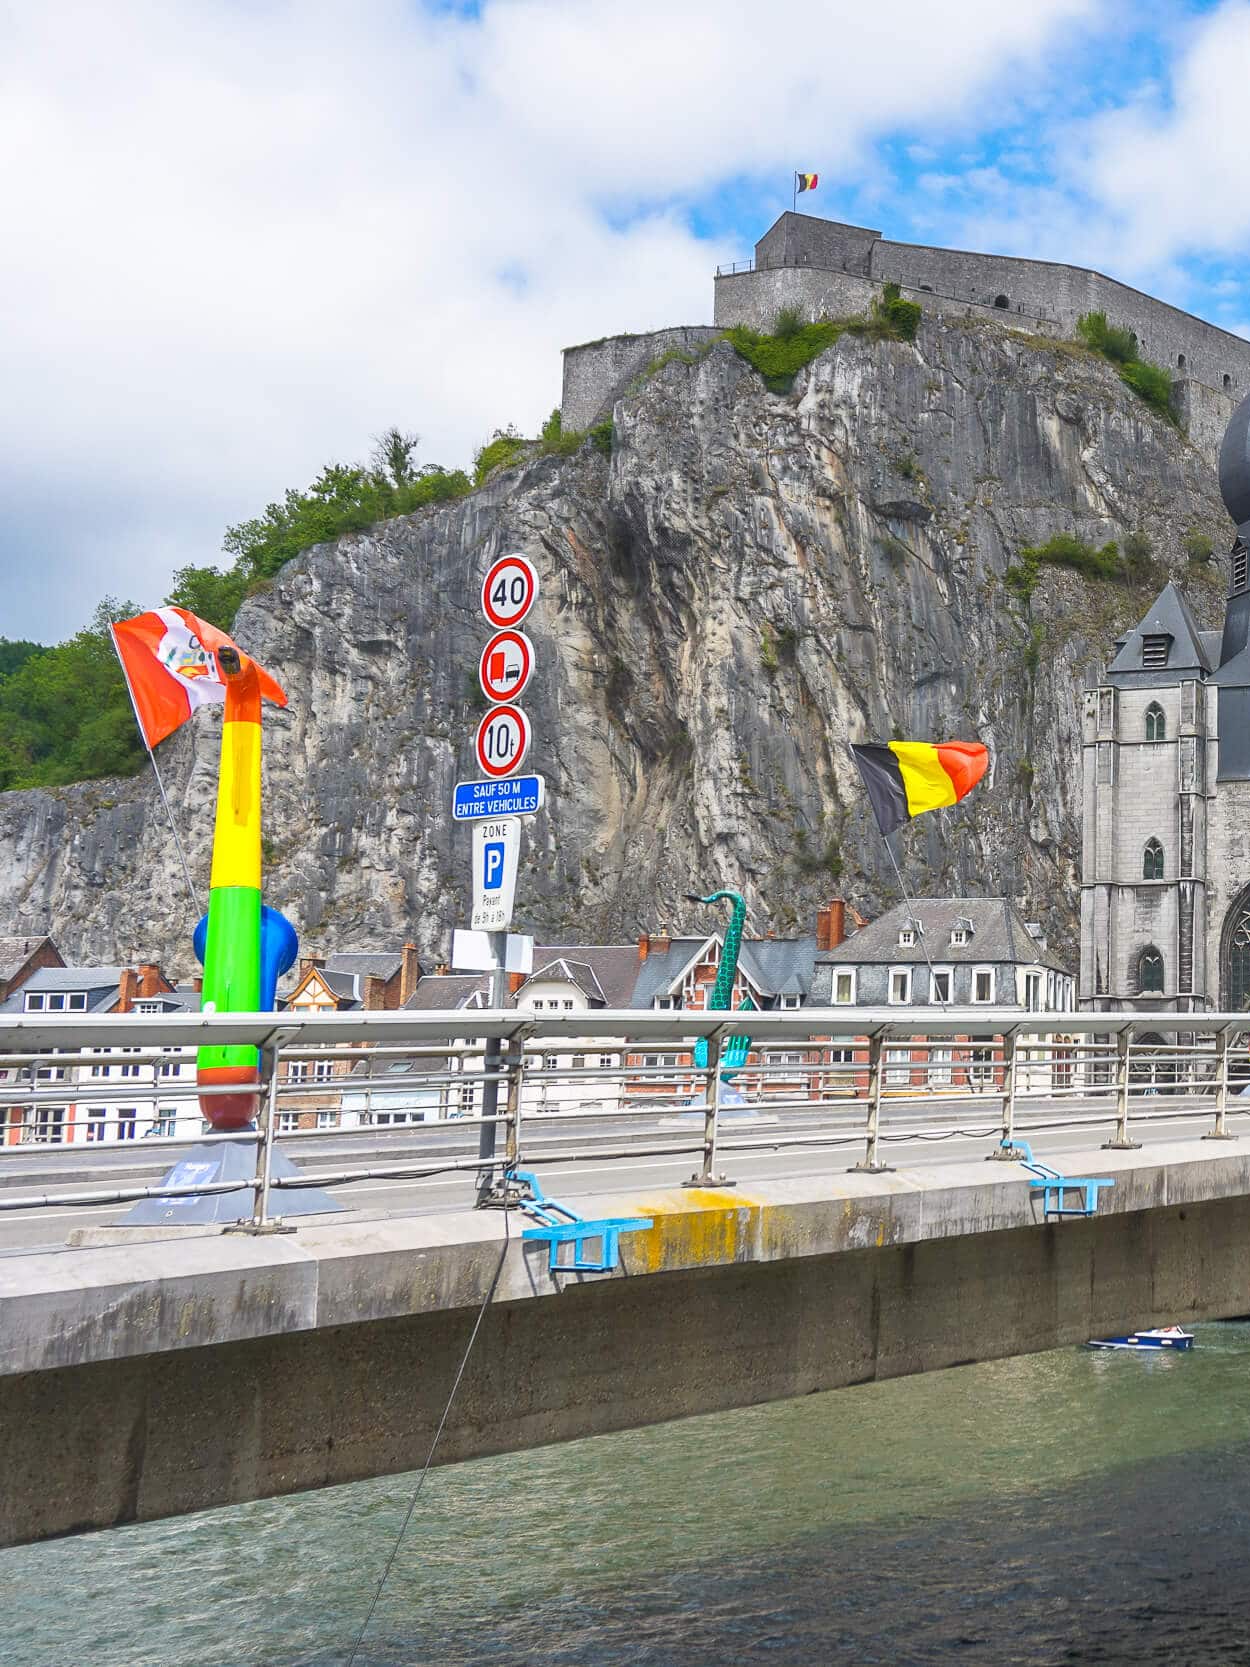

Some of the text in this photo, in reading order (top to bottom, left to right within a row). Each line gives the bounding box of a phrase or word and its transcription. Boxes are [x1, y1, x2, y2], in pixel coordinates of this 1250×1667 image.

[492, 577, 525, 606] 40
[473, 782, 520, 798] SAUF 50 M
[456, 796, 536, 816] ENTRE VEHICULES
[482, 824, 507, 838] ZONE
[487, 849, 501, 883] P
